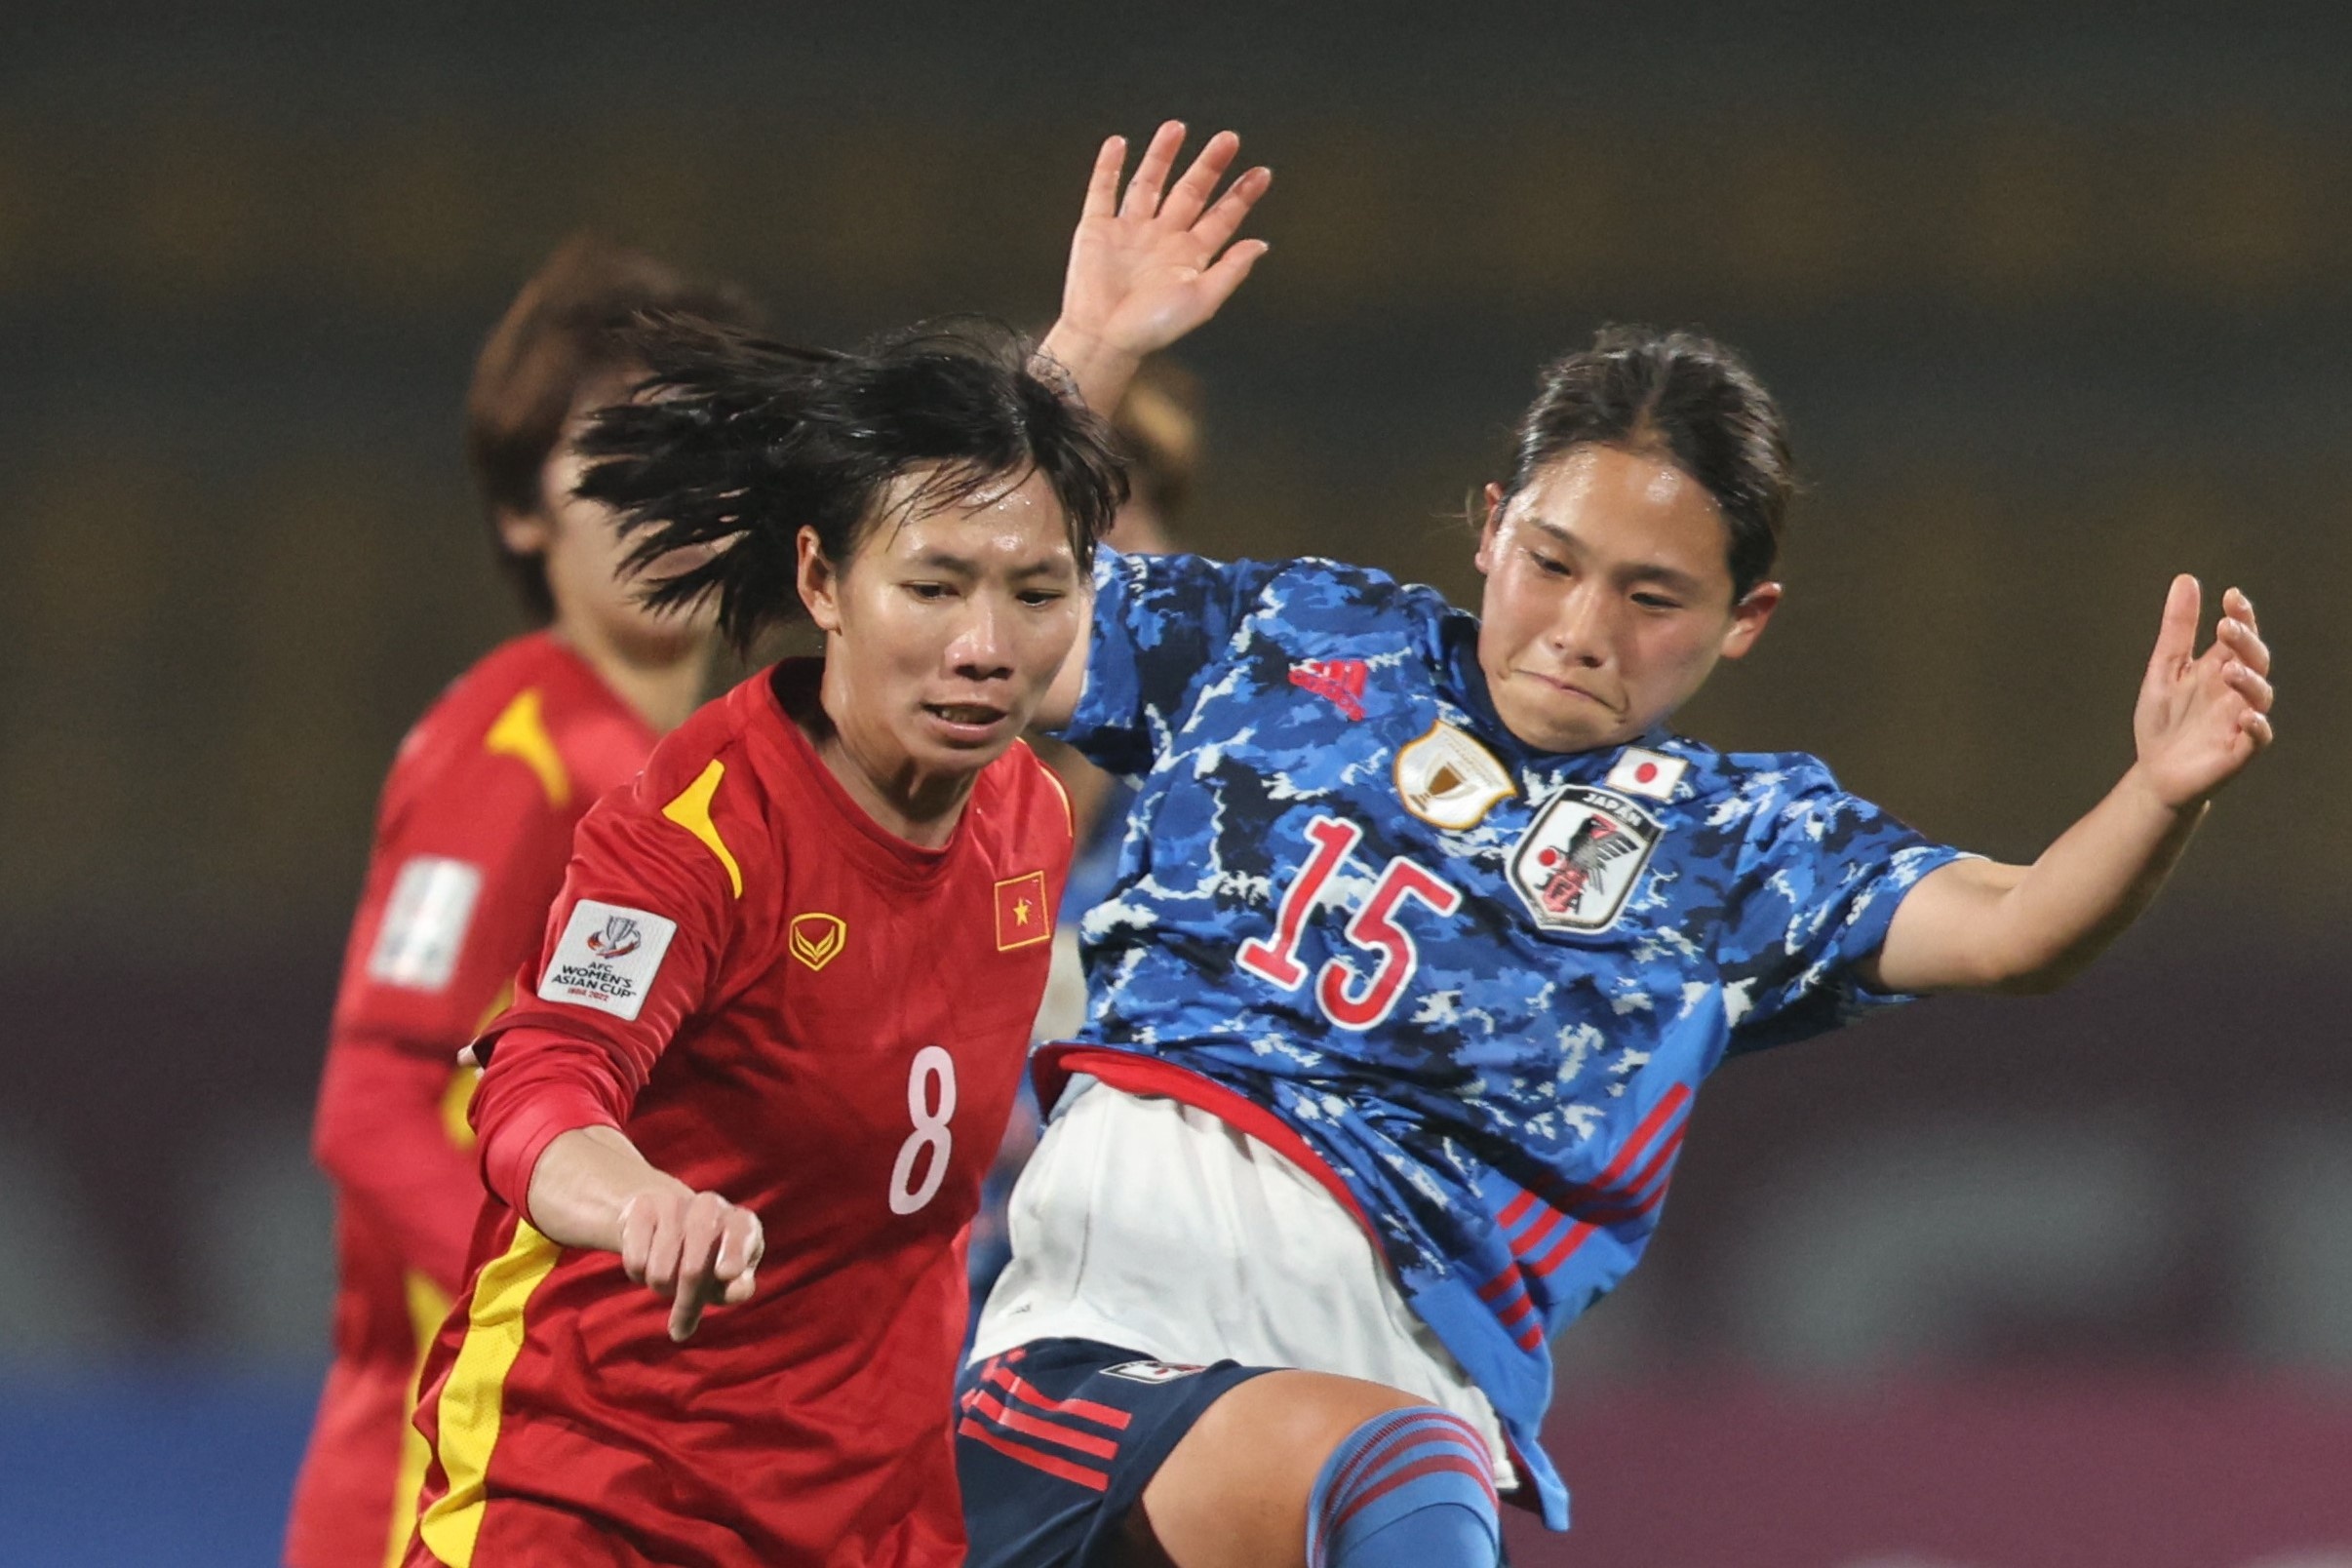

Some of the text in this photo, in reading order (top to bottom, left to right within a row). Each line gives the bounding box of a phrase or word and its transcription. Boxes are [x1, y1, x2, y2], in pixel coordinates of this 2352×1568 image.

[1583, 793, 1642, 827] JAPAN
[1235, 814, 1463, 1031] 15
[562, 965, 633, 988] WOMEN'S
[589, 961, 613, 973] AFC
[551, 974, 598, 989] ASIAN
[887, 1044, 958, 1215] 8
